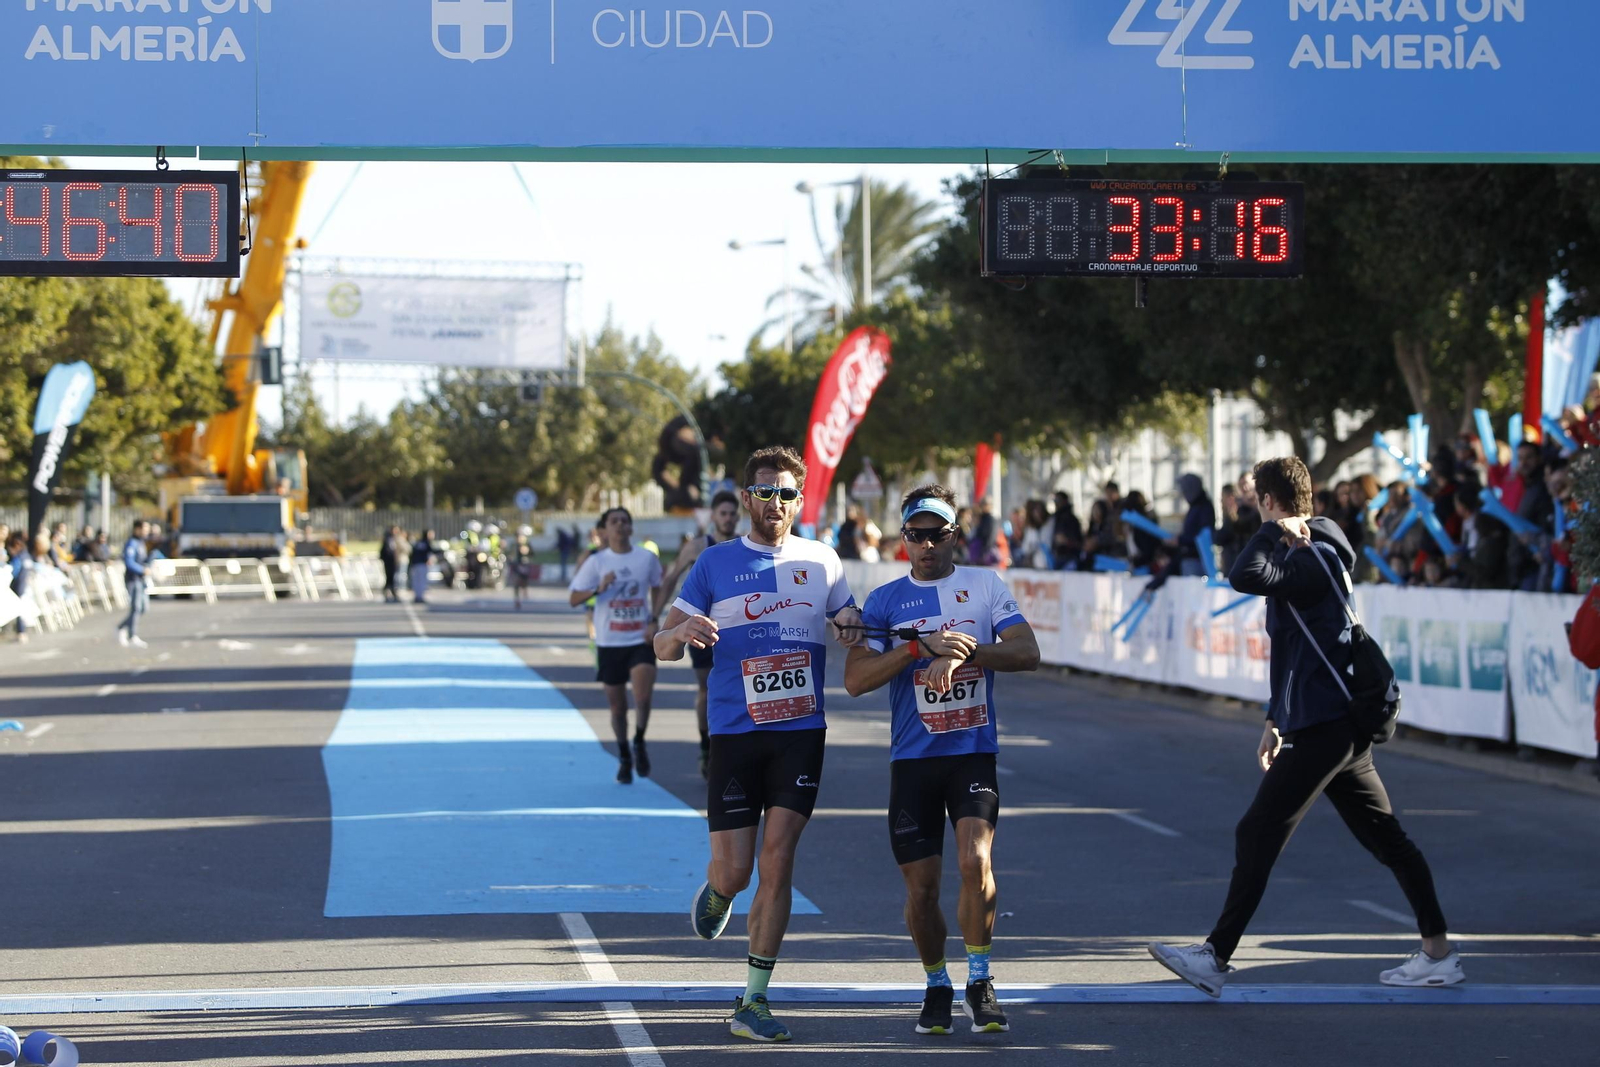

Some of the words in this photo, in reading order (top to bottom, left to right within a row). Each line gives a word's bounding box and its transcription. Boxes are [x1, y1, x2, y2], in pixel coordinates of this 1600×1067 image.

[24, 15, 246, 63] ALMERÍA
[591, 8, 774, 49] CIUDAD
[1288, 24, 1501, 71] ALMERÍA
[1109, 196, 1288, 262] 33:16
[1088, 262, 1152, 271] CRONOMETRAJE
[1153, 263, 1198, 272] DEPORTIVO
[734, 572, 760, 583] GOBIK
[743, 593, 813, 621] Cune
[768, 626, 810, 638] MARSH
[781, 660, 806, 668] SALUDABLE
[752, 668, 807, 694] 6266
[924, 679, 979, 704] 6267
